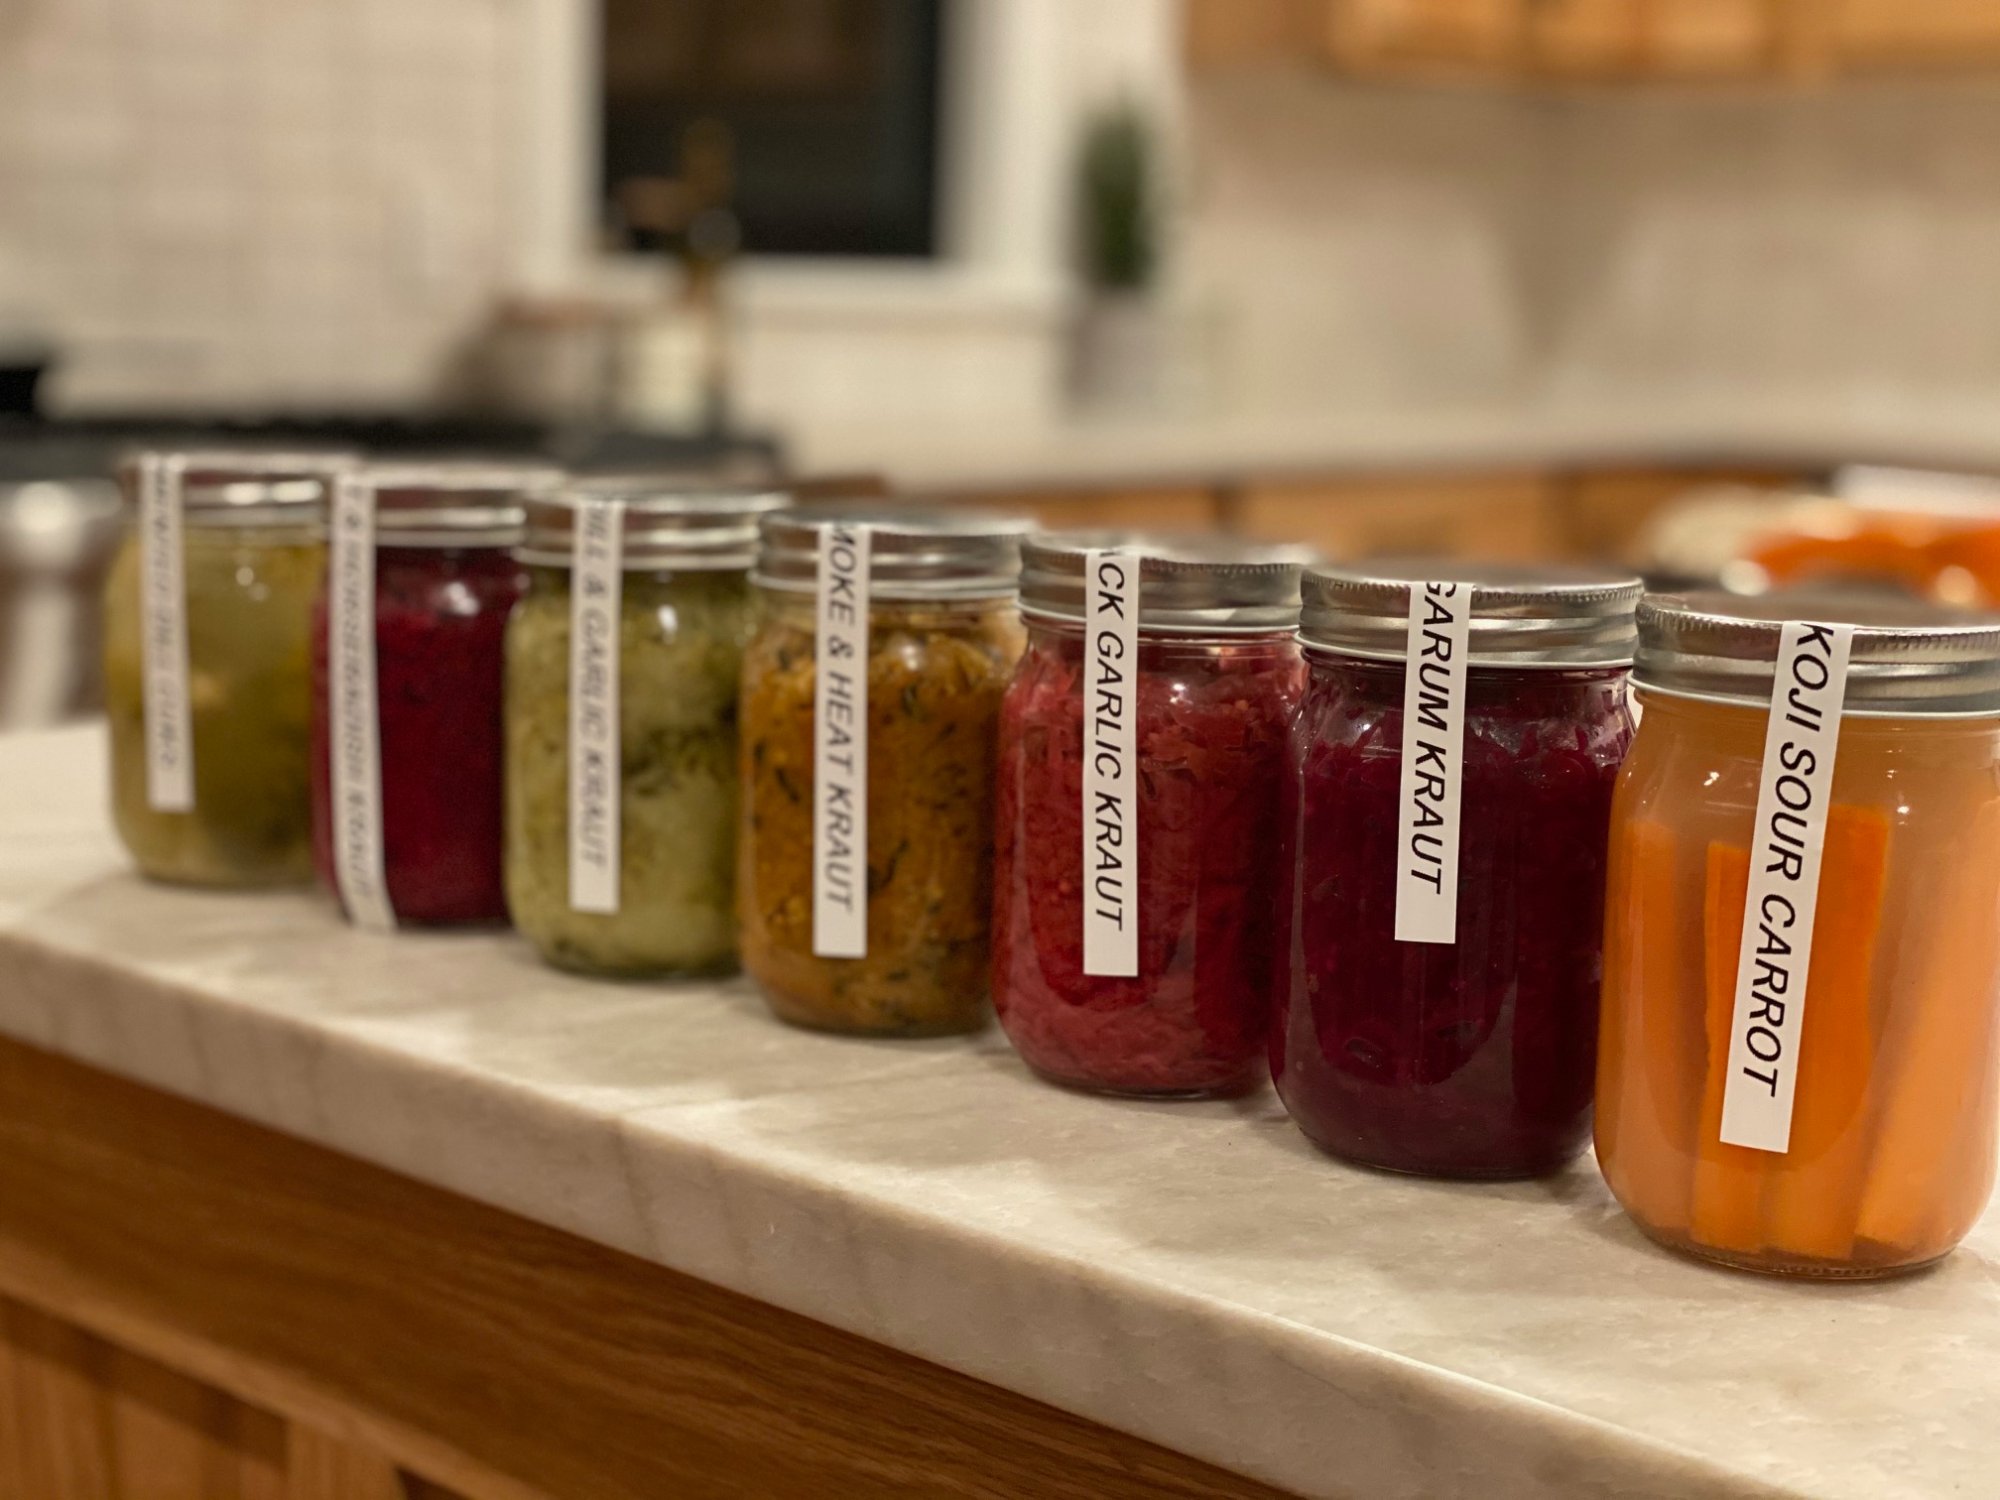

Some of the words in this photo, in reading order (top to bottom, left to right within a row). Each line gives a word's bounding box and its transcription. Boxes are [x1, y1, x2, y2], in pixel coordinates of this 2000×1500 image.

[580, 607, 609, 742] GARLIC
[827, 634, 855, 658] &
[1093, 630, 1125, 780] GARLIC
[1416, 582, 1457, 732] GARUM
[1785, 623, 1836, 733] KOJI
[826, 670, 854, 776] HEAT
[579, 745, 609, 869] KRAUT
[824, 782, 854, 912] KRAUT
[1094, 790, 1123, 931] KRAUT
[1410, 740, 1447, 895] KRAUT
[1765, 741, 1816, 881] SOUR
[1741, 894, 1796, 1097] CARROT
